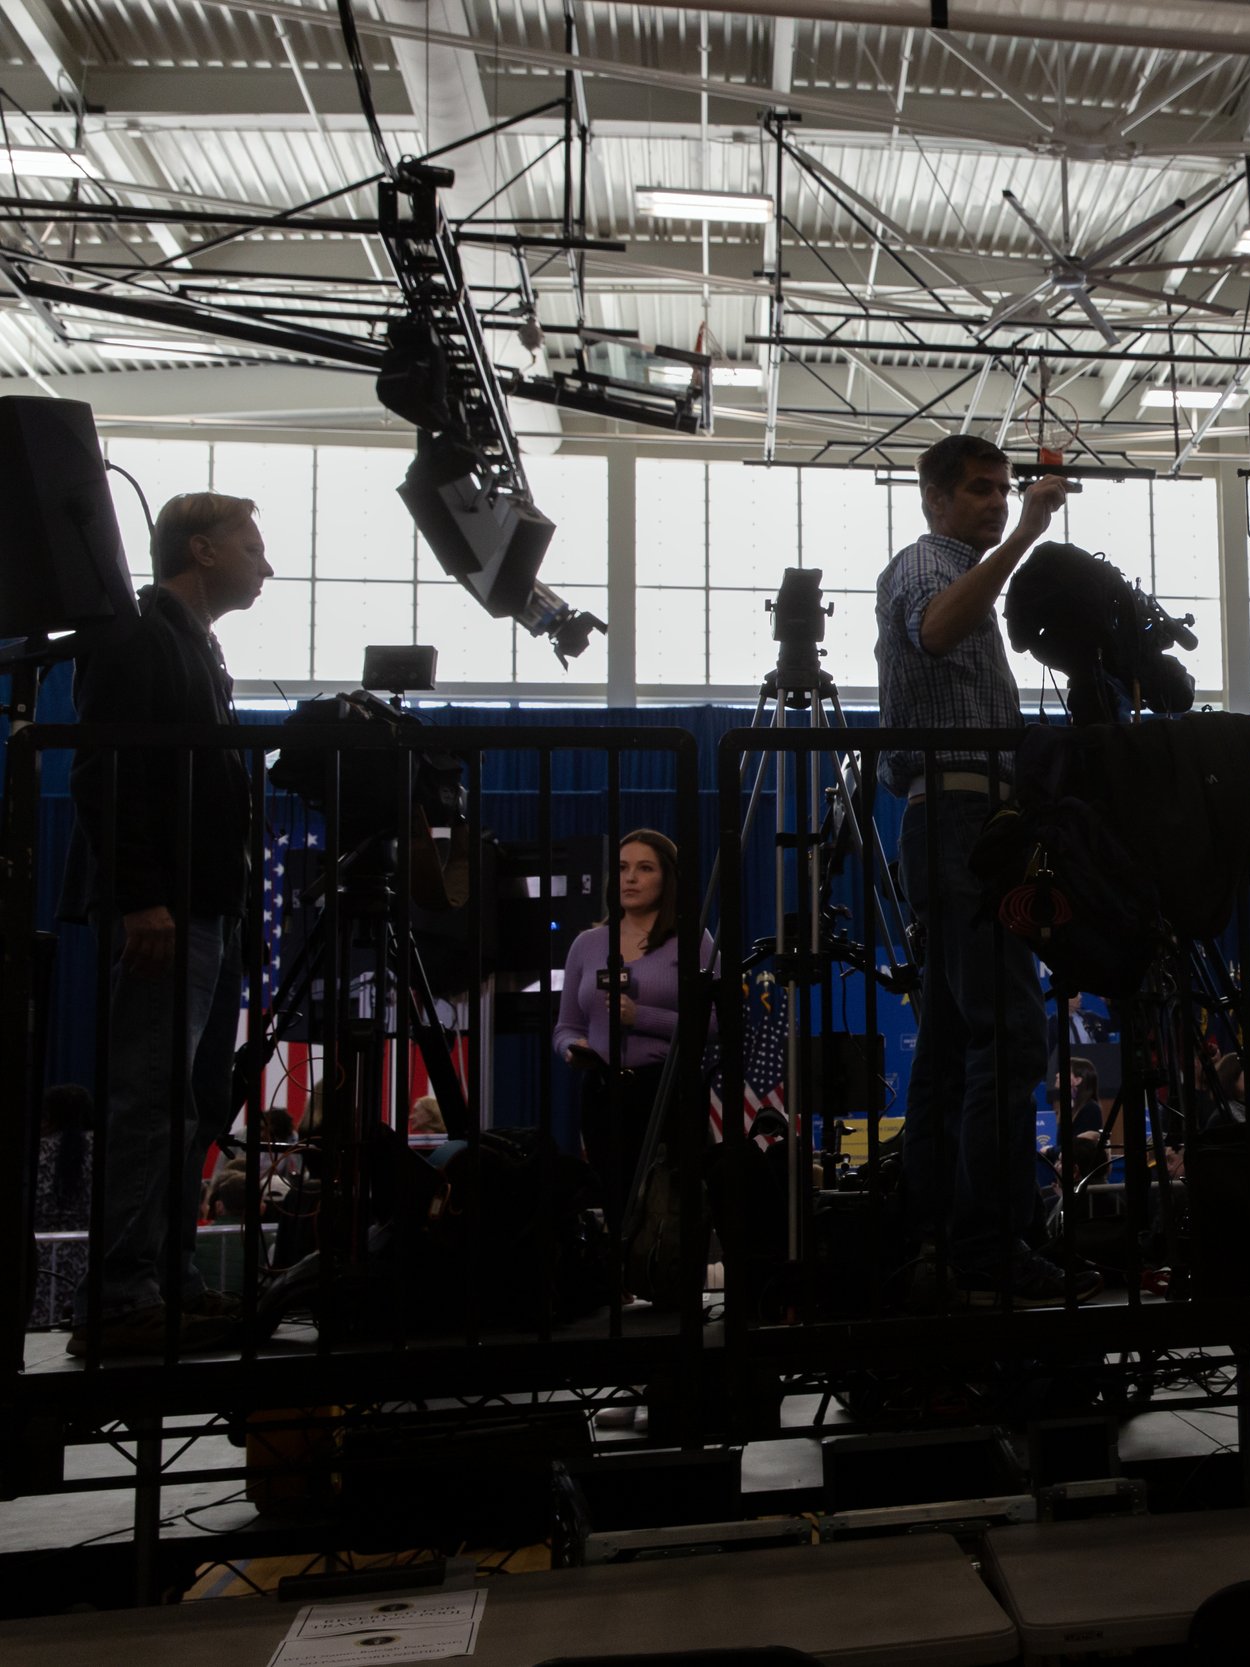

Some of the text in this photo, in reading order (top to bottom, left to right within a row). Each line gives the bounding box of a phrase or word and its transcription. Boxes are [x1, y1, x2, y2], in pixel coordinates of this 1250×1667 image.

[312, 1608, 466, 1629] TRAVELING POOL
[324, 1604, 457, 1624] RESERVED FOR
